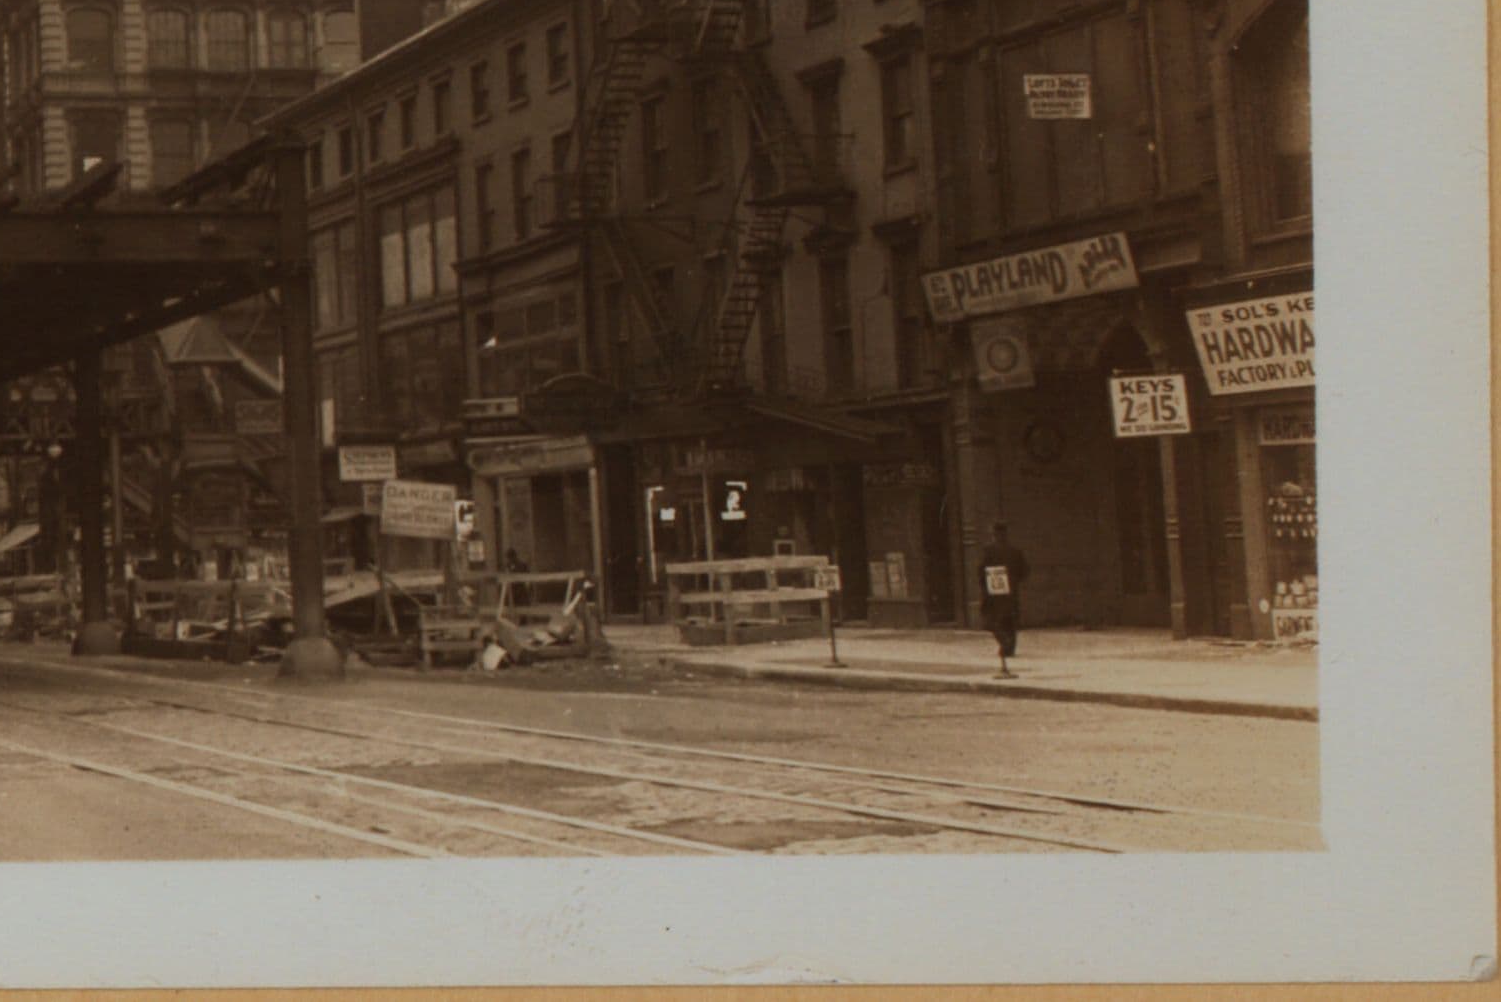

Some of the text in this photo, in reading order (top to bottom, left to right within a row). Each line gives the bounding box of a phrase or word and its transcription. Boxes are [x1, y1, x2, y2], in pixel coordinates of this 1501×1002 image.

[949, 250, 1067, 312] PLAYLAND
[1221, 302, 1279, 324] SOL'S
[1200, 317, 1315, 366] HARDWA
[1119, 378, 1175, 395] KEYS
[1217, 362, 1287, 388] FACTORY
[1119, 396, 1138, 424] 2
[386, 485, 454, 502] DANGER
